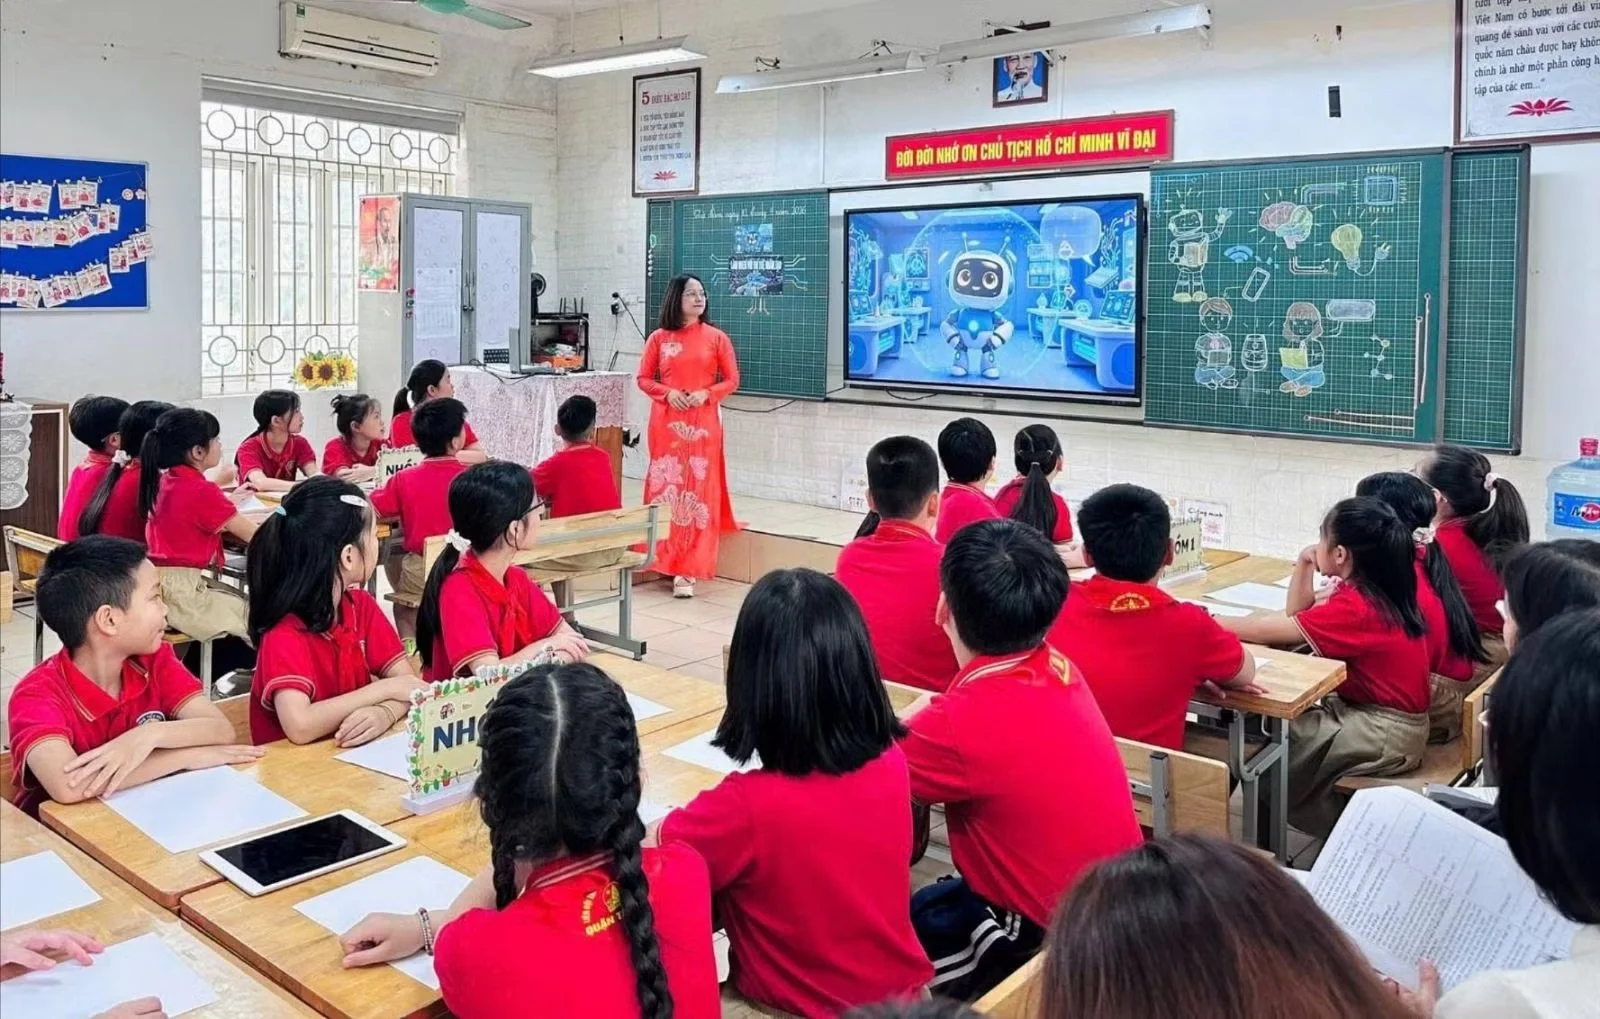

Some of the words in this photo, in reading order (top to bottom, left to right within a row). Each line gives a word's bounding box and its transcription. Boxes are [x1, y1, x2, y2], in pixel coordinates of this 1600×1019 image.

[1495, 12, 1514, 22] Nam
[1518, 8, 1528, 20] có
[1475, 33, 1499, 45] quang
[1514, 27, 1533, 38] sánh
[1536, 26, 1548, 35] vai
[1567, 20, 1580, 31] các
[1583, 18, 1600, 30] cườ
[1539, 43, 1559, 53] được
[1562, 40, 1577, 52] hay
[1475, 65, 1496, 77] chính
[1499, 64, 1507, 75] là
[1528, 60, 1544, 73] một
[1571, 56, 1591, 68] công
[1505, 80, 1517, 92] các
[642, 91, 650, 105] 5
[896, 146, 914, 168] ĐỜI
[916, 144, 934, 166] ĐỜI
[937, 140, 960, 164] NHỚ
[962, 143, 978, 162] ƠN
[981, 134, 1004, 160] CHỦ
[1006, 138, 1032, 162] TỊCH
[1055, 131, 1077, 155] CHÍ
[1079, 132, 1114, 153] MINH
[1117, 127, 1131, 150] VĨ
[1133, 128, 1157, 152] ĐẠI
[1175, 533, 1189, 555] ÓM
[1190, 536, 1195, 551] 1
[433, 716, 476, 753] NH
